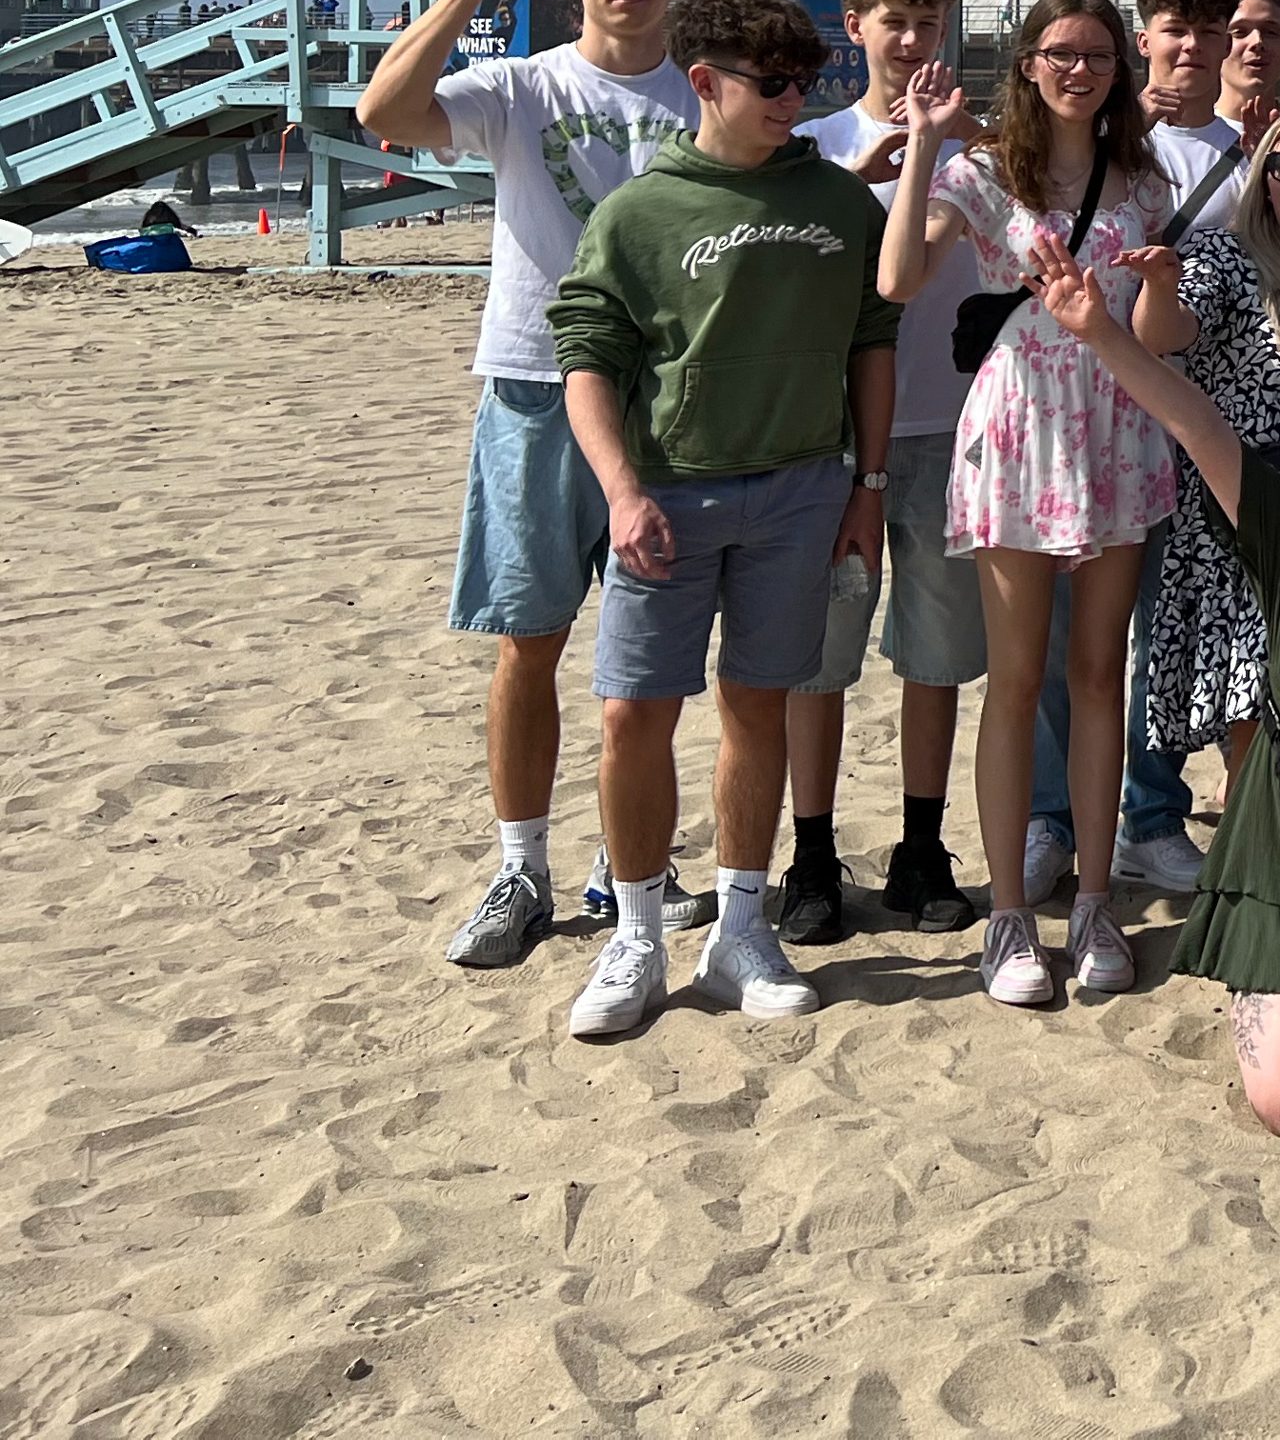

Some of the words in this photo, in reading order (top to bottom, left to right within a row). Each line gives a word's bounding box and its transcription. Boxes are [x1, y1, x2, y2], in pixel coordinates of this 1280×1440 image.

[470, 18, 493, 35] SEE
[457, 37, 506, 54] WHAT'S
[681, 222, 845, 280] Reternity
